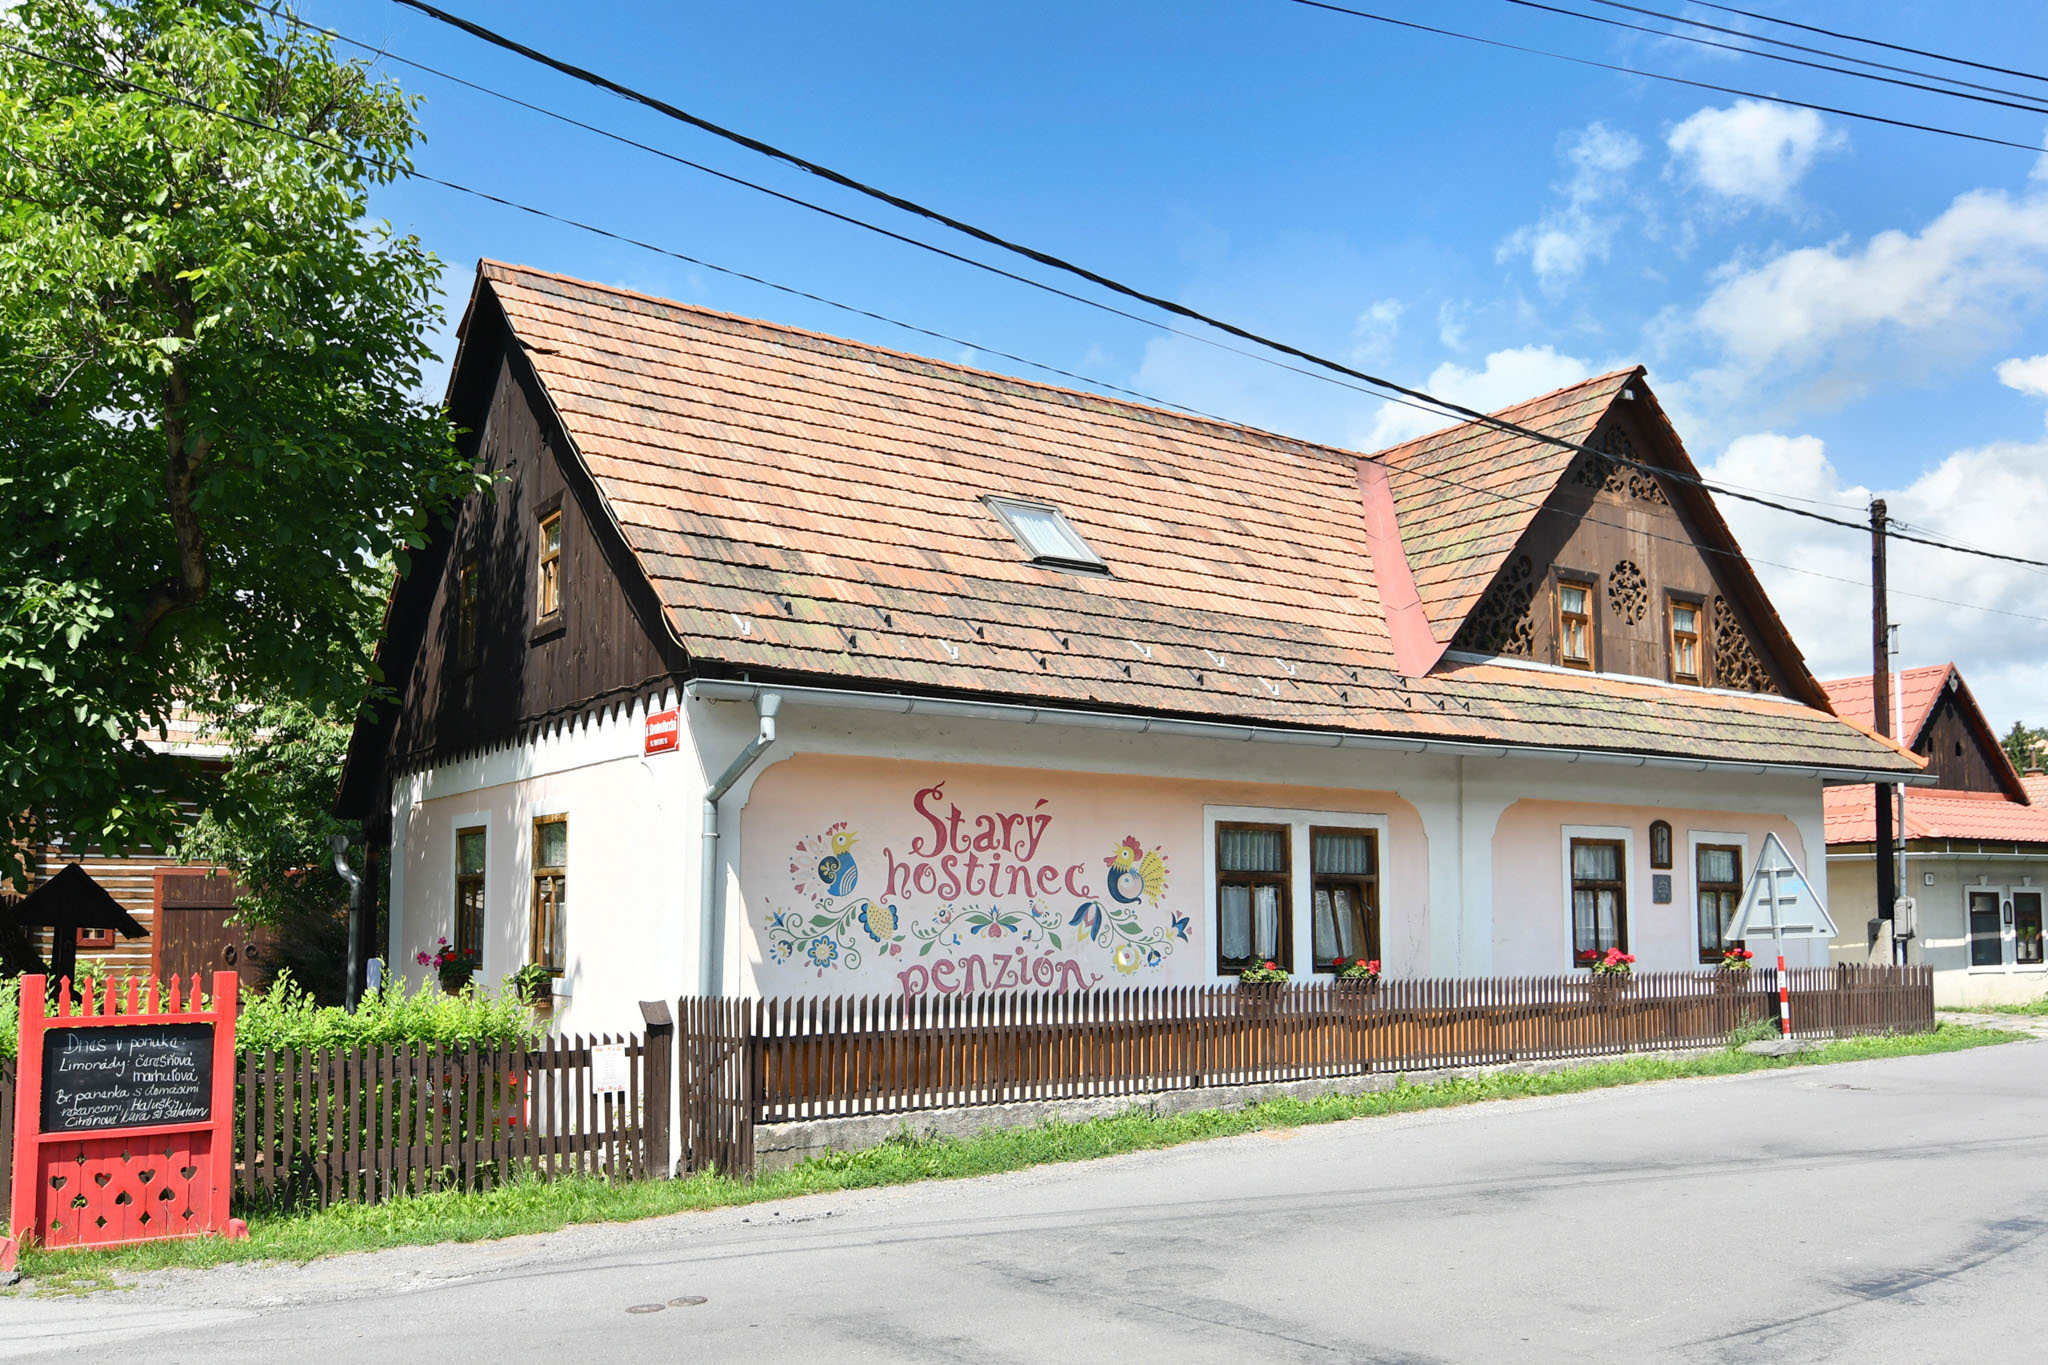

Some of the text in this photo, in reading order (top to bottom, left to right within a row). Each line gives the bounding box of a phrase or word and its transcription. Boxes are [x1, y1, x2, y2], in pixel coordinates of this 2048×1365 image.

[908, 780, 1052, 862] Starý
[880, 847, 1100, 904] hostinec
[897, 946, 1104, 1018] penzión
[63, 1033, 107, 1055] Dnes
[116, 1039, 123, 1051] v
[73, 1085, 130, 1110] panenka
[132, 1088, 142, 1097] s
